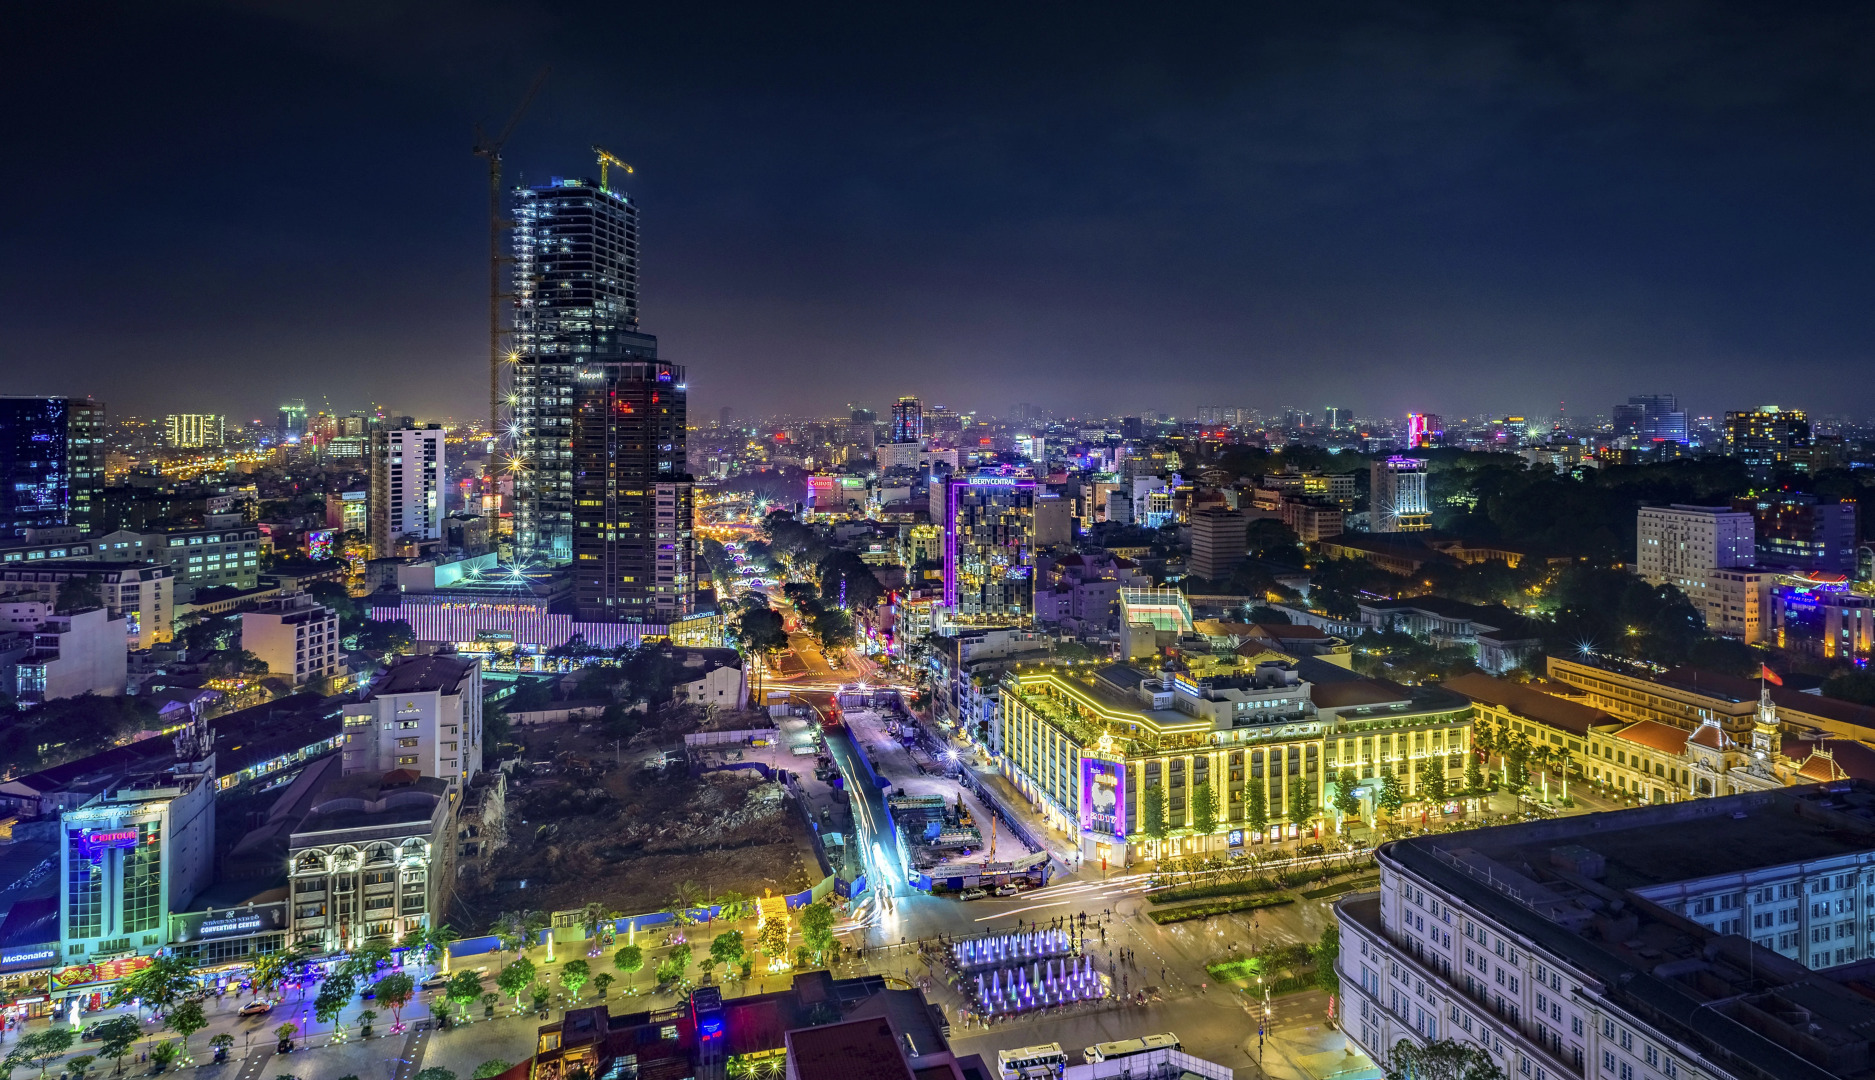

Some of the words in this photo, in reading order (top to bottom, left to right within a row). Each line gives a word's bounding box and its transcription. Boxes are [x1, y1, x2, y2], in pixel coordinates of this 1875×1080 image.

[1090, 811, 1118, 824] 2017
[200, 923, 237, 934] CONVENTION
[238, 920, 261, 930] CENTER
[2, 950, 54, 964] McDonald's
